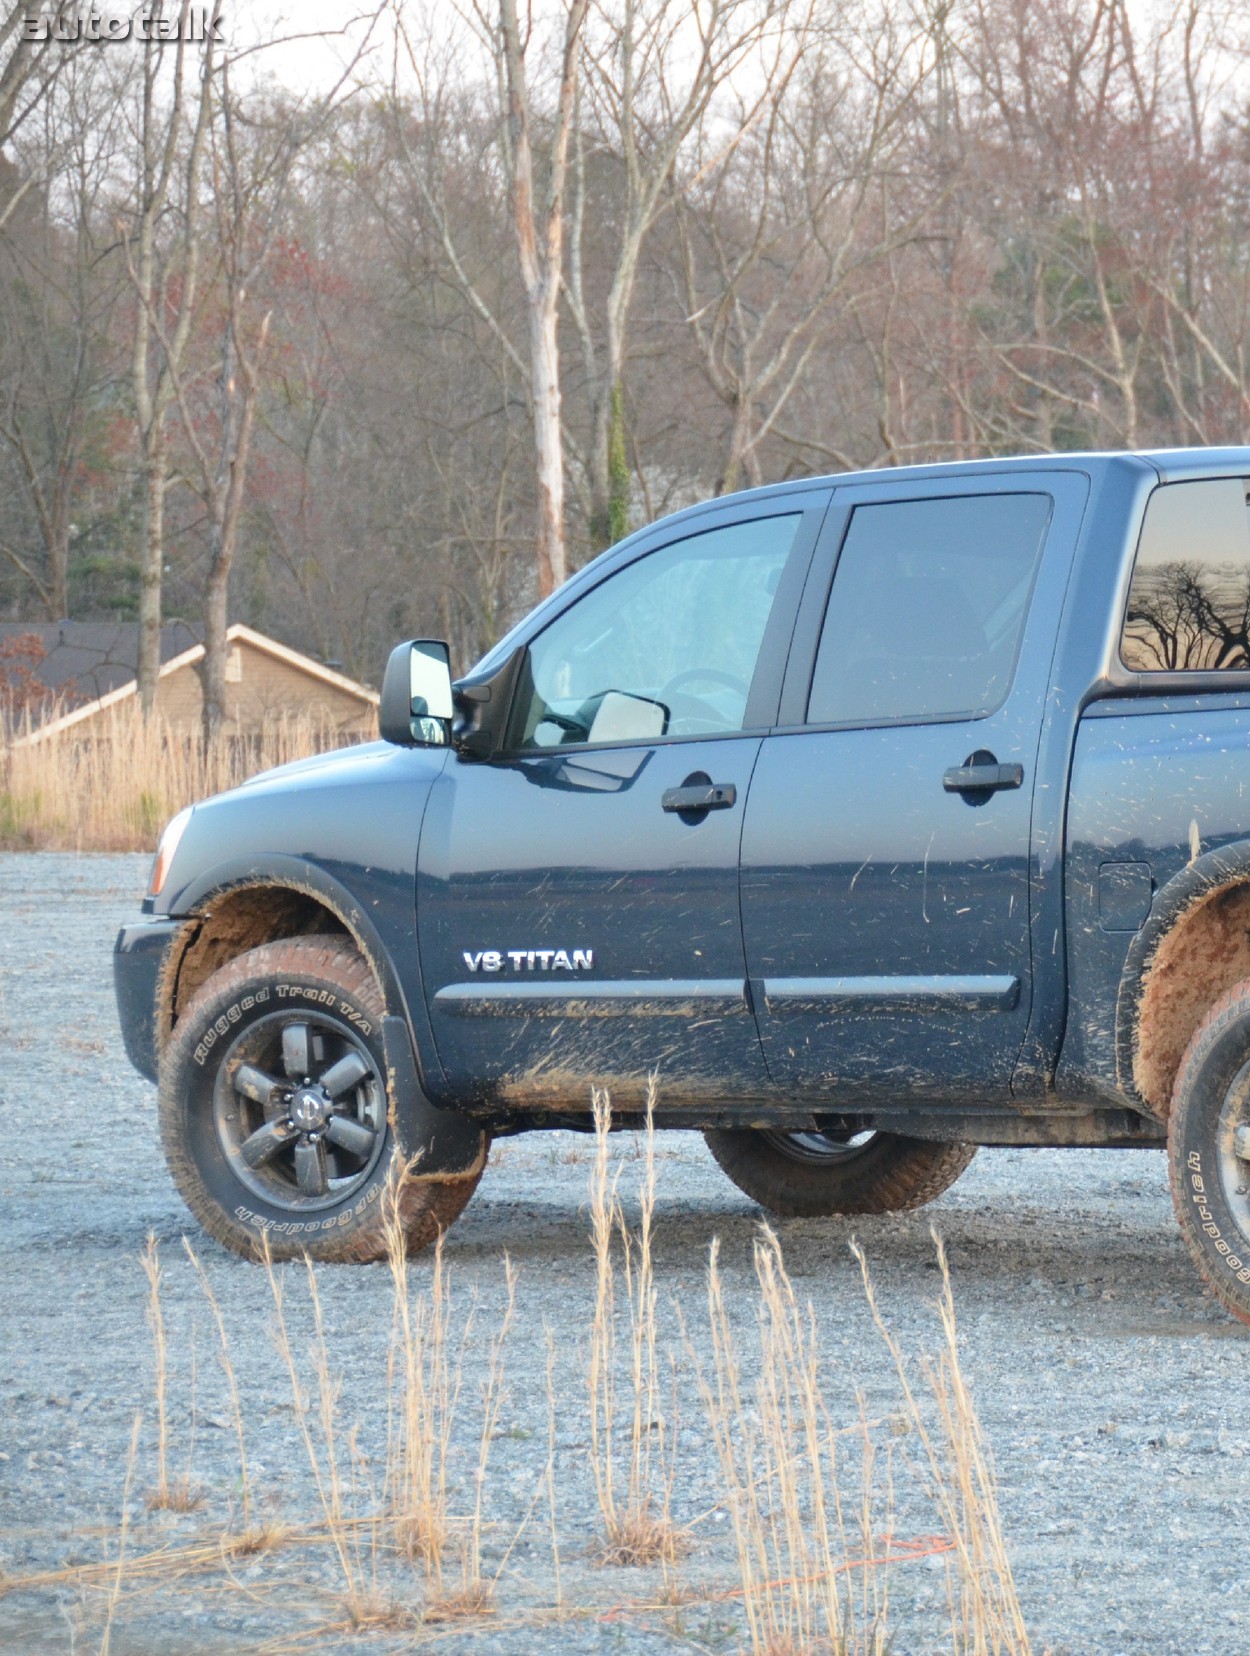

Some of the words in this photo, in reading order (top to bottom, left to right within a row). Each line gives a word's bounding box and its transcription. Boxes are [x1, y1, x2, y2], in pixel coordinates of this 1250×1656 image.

[463, 951, 502, 972] V8
[507, 949, 594, 972] TITAN
[193, 987, 270, 1066] Rugged
[276, 984, 336, 1007] Trail
[340, 1001, 372, 1036] T/A
[234, 1183, 381, 1235] BFGoodrich
